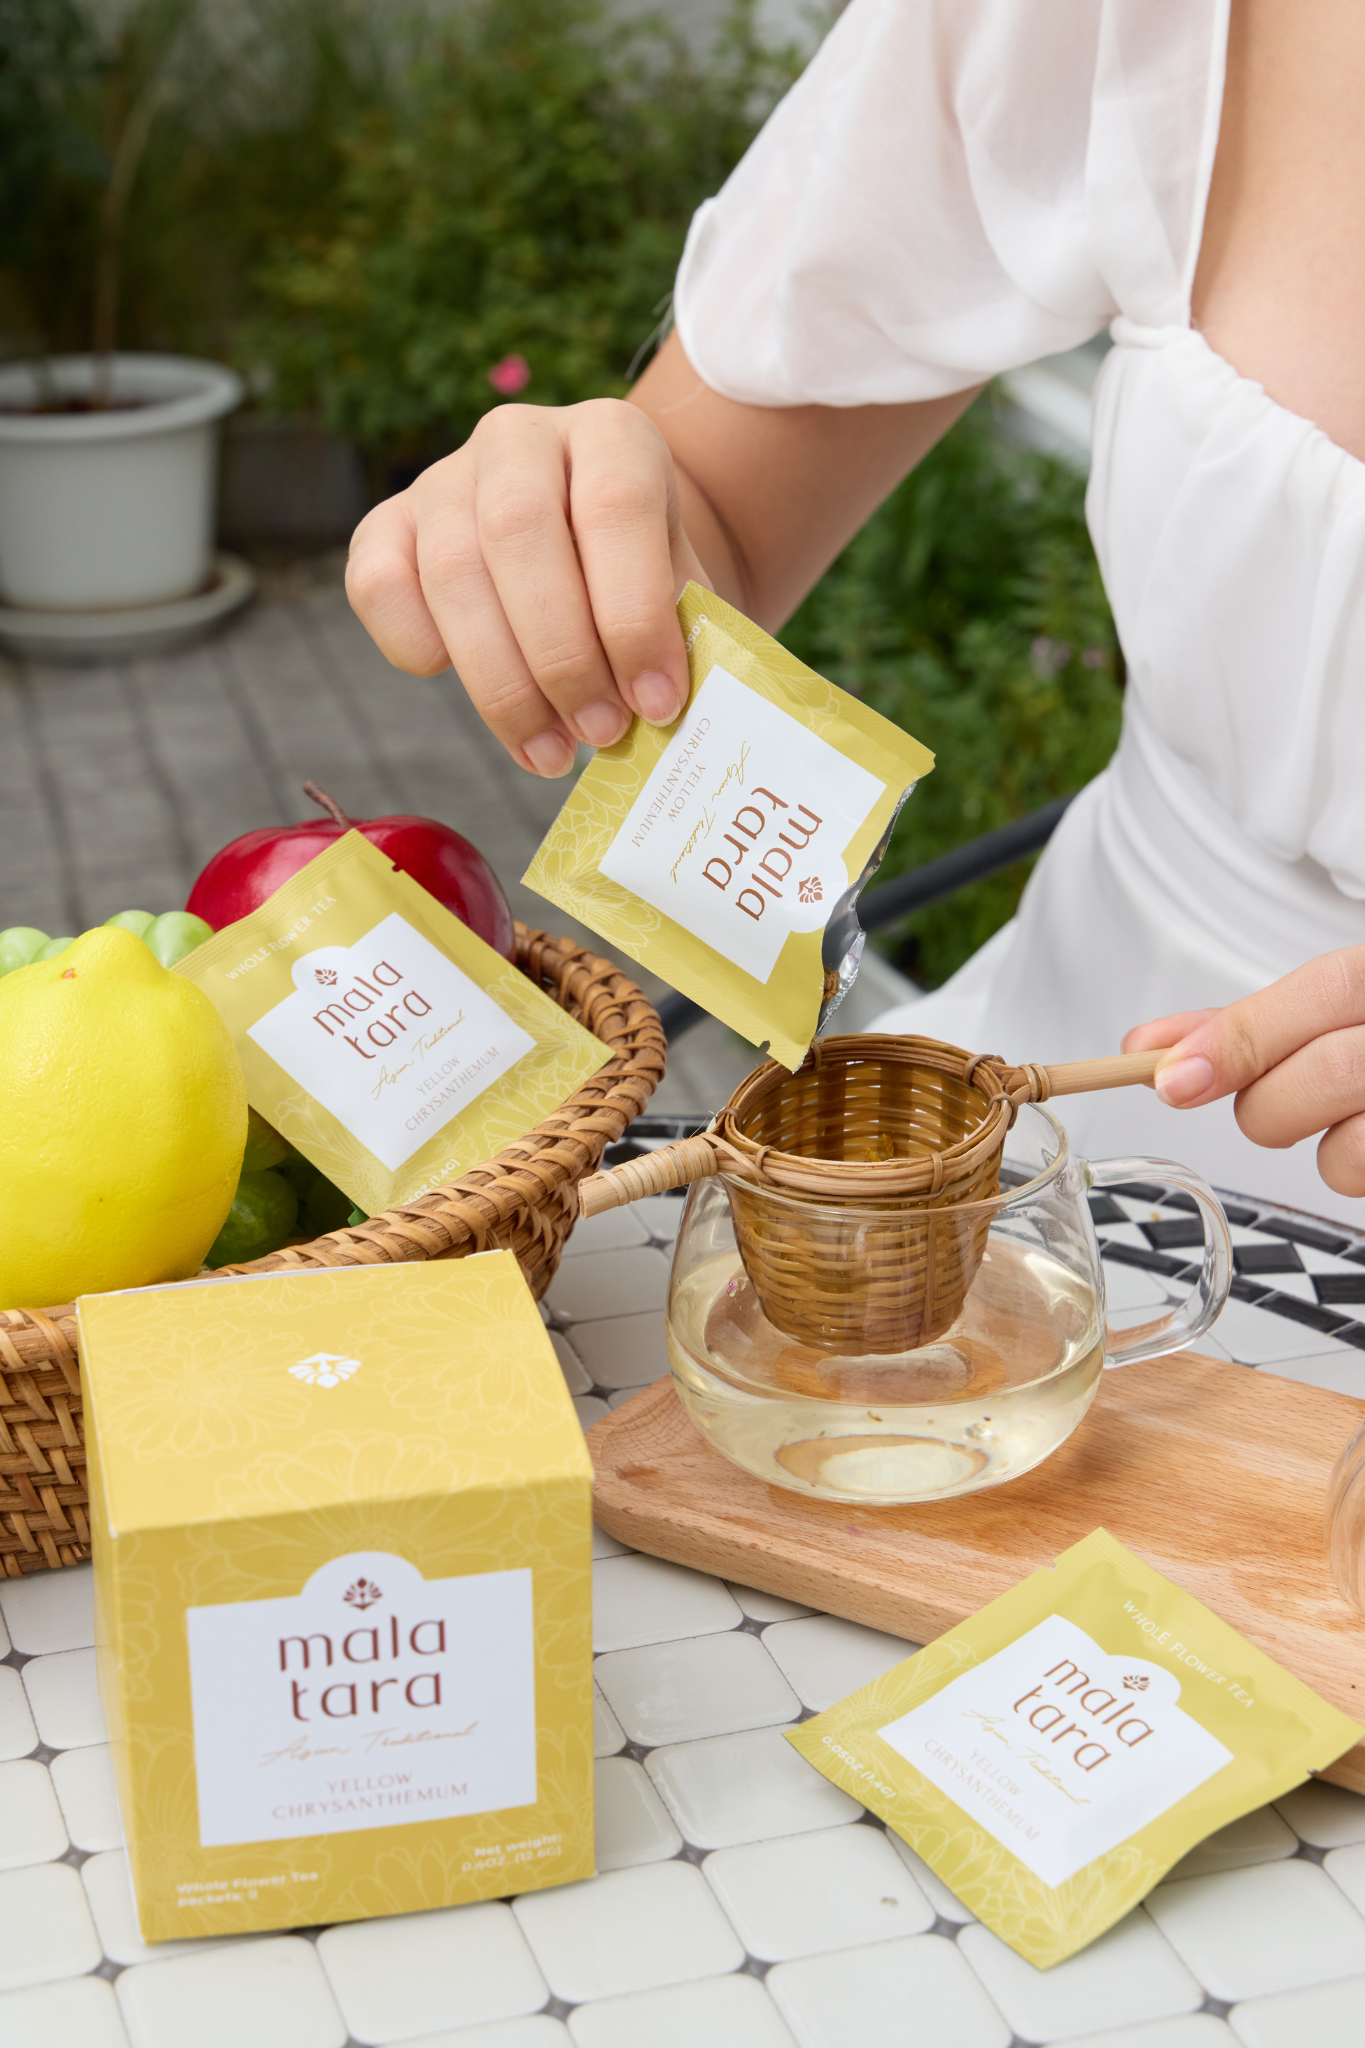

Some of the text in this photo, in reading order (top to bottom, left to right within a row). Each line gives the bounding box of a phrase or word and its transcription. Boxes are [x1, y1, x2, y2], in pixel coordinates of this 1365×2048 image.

[632, 718, 711, 848] CHRYSANTHEMUM
[668, 764, 706, 824] YELLOW
[670, 741, 750, 884] Asian Traditional
[702, 786, 788, 892] tara
[735, 803, 823, 922] mala
[225, 896, 338, 980] WHOLE FLOWER TEA
[312, 960, 404, 1036] mala
[343, 990, 433, 1059] tara
[371, 1009, 466, 1100] Asian Traditional
[405, 1046, 500, 1131] CHRYSANTHEMUM
[416, 1055, 460, 1095] YELLOW
[278, 1615, 447, 1672] mala
[1123, 1600, 1255, 1708] WHOLE FLOWER TEA
[292, 1671, 442, 1722] tara
[1012, 1684, 1113, 1773] tara
[1043, 1657, 1156, 1748] mala
[258, 1721, 479, 1767] Asian Traditional
[327, 1772, 413, 1795] YELLOW
[962, 1709, 1092, 1806] Asian Traditional
[968, 1750, 1024, 1797] YELLOW
[272, 1783, 468, 1820] CHRYSANTHEMUM
[924, 1739, 1040, 1842] CHRYSANTHEMUM
[176, 1871, 318, 1894] Whole Flower Tea
[475, 1844, 501, 1858] Net
